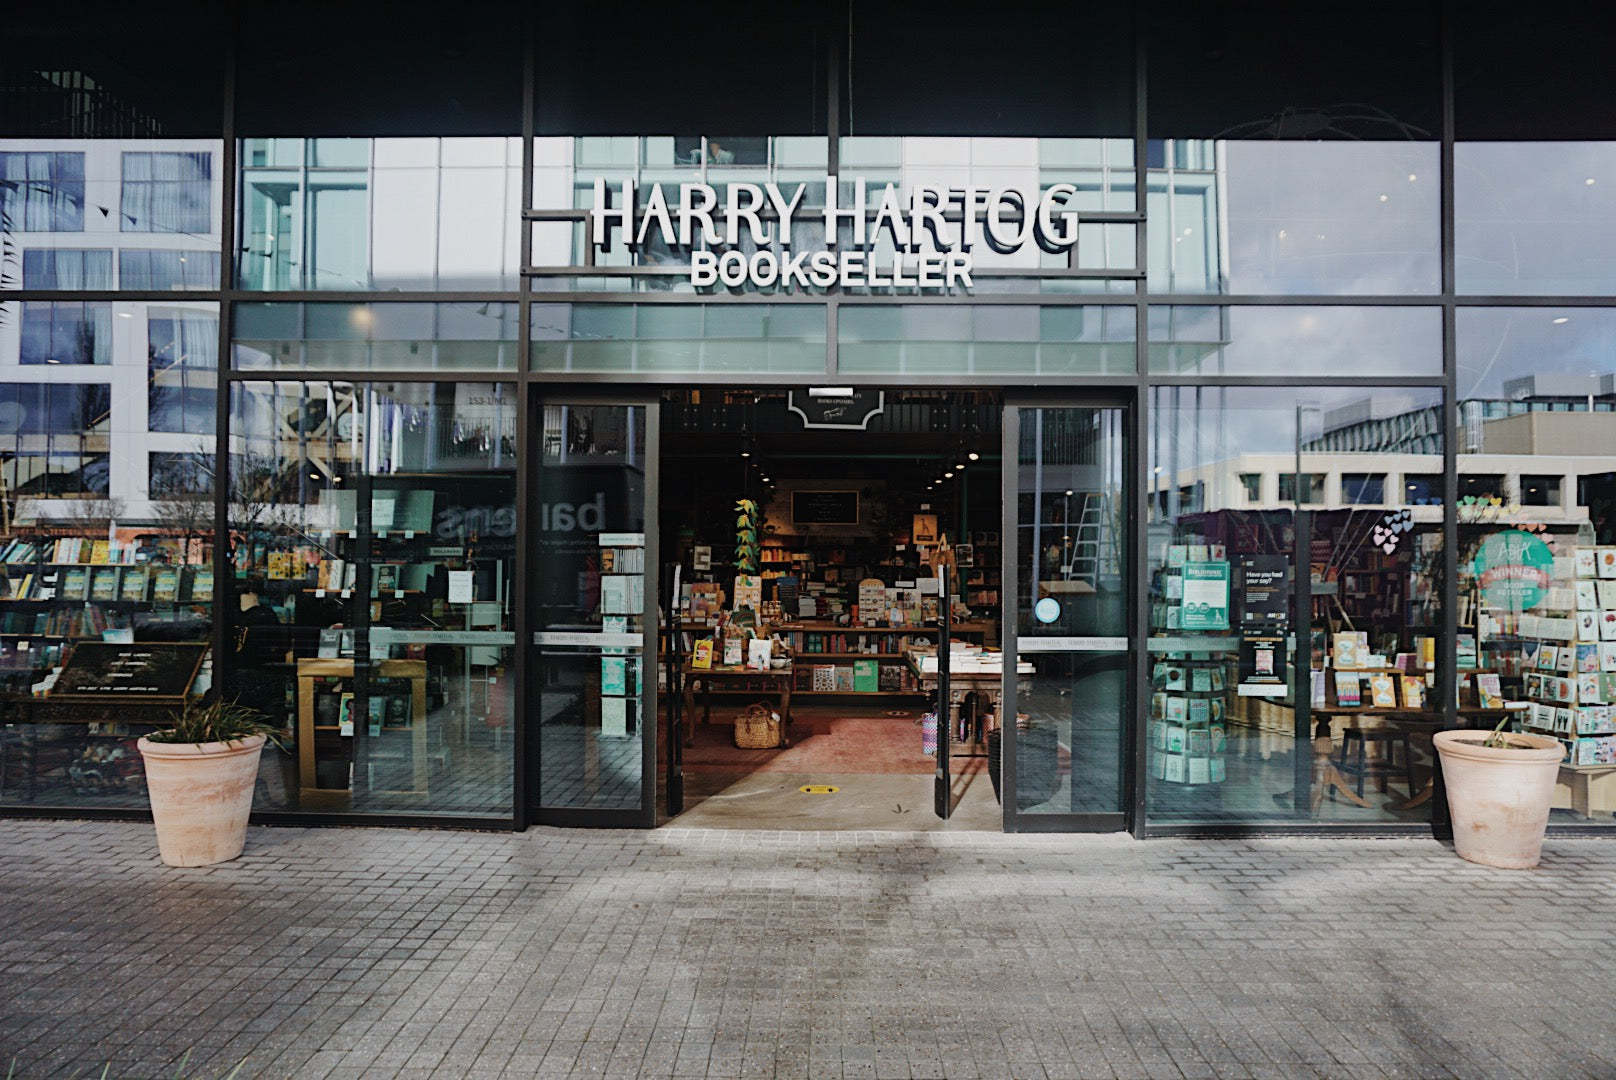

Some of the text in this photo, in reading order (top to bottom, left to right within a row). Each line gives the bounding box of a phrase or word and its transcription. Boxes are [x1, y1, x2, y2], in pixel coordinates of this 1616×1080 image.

[592, 175, 1079, 248] HARRY HARTOG
[690, 250, 974, 289] BOOKSELLER
[1491, 566, 1539, 579] WINNER
